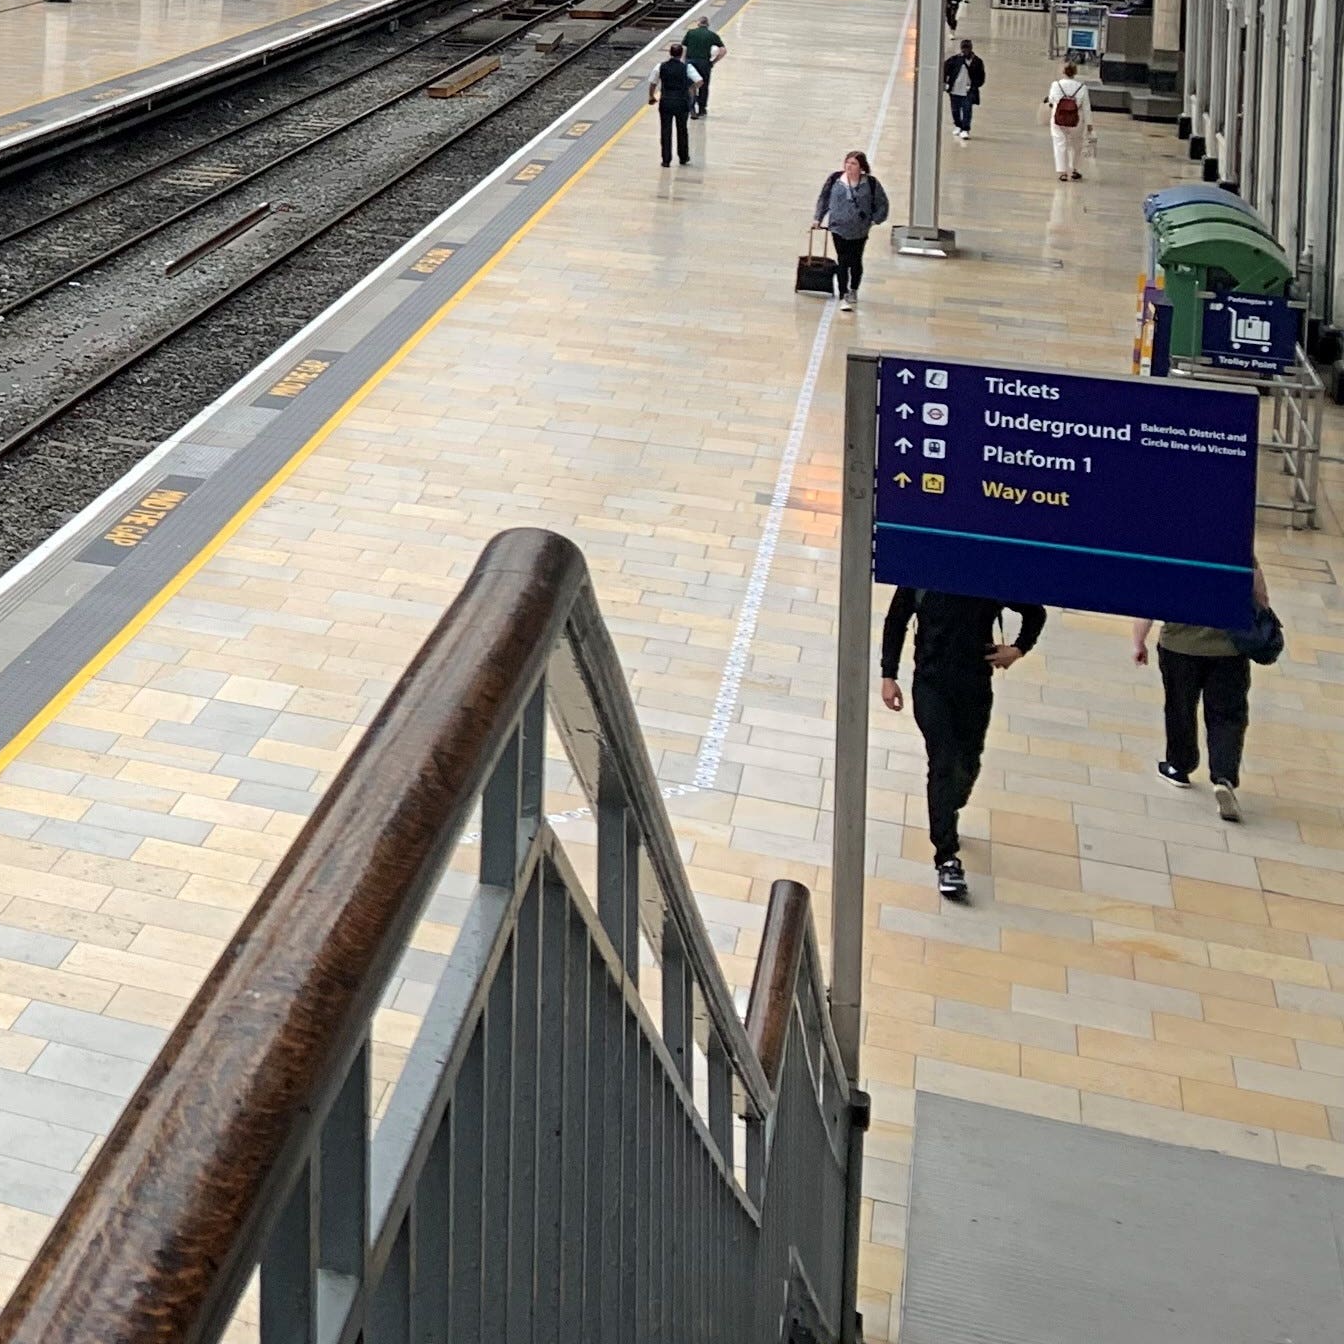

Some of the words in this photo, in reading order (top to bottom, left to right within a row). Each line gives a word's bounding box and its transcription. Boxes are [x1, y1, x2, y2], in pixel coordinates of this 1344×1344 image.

[1218, 356, 1250, 368] Trolley
[1252, 359, 1277, 370] Point
[985, 376, 1060, 400] Tickets
[984, 410, 1131, 442] Underground
[1140, 423, 1187, 437] Bakerloo,
[1189, 428, 1225, 441] District
[1227, 434, 1247, 443] and
[983, 445, 1076, 471] Platform
[1082, 456, 1093, 473] 1
[1140, 437, 1169, 448] Circle
[1171, 441, 1189, 450] line
[1192, 443, 1206, 453] via
[1207, 444, 1247, 457] Victoria
[981, 480, 1027, 505] Way
[1031, 489, 1070, 507] out
